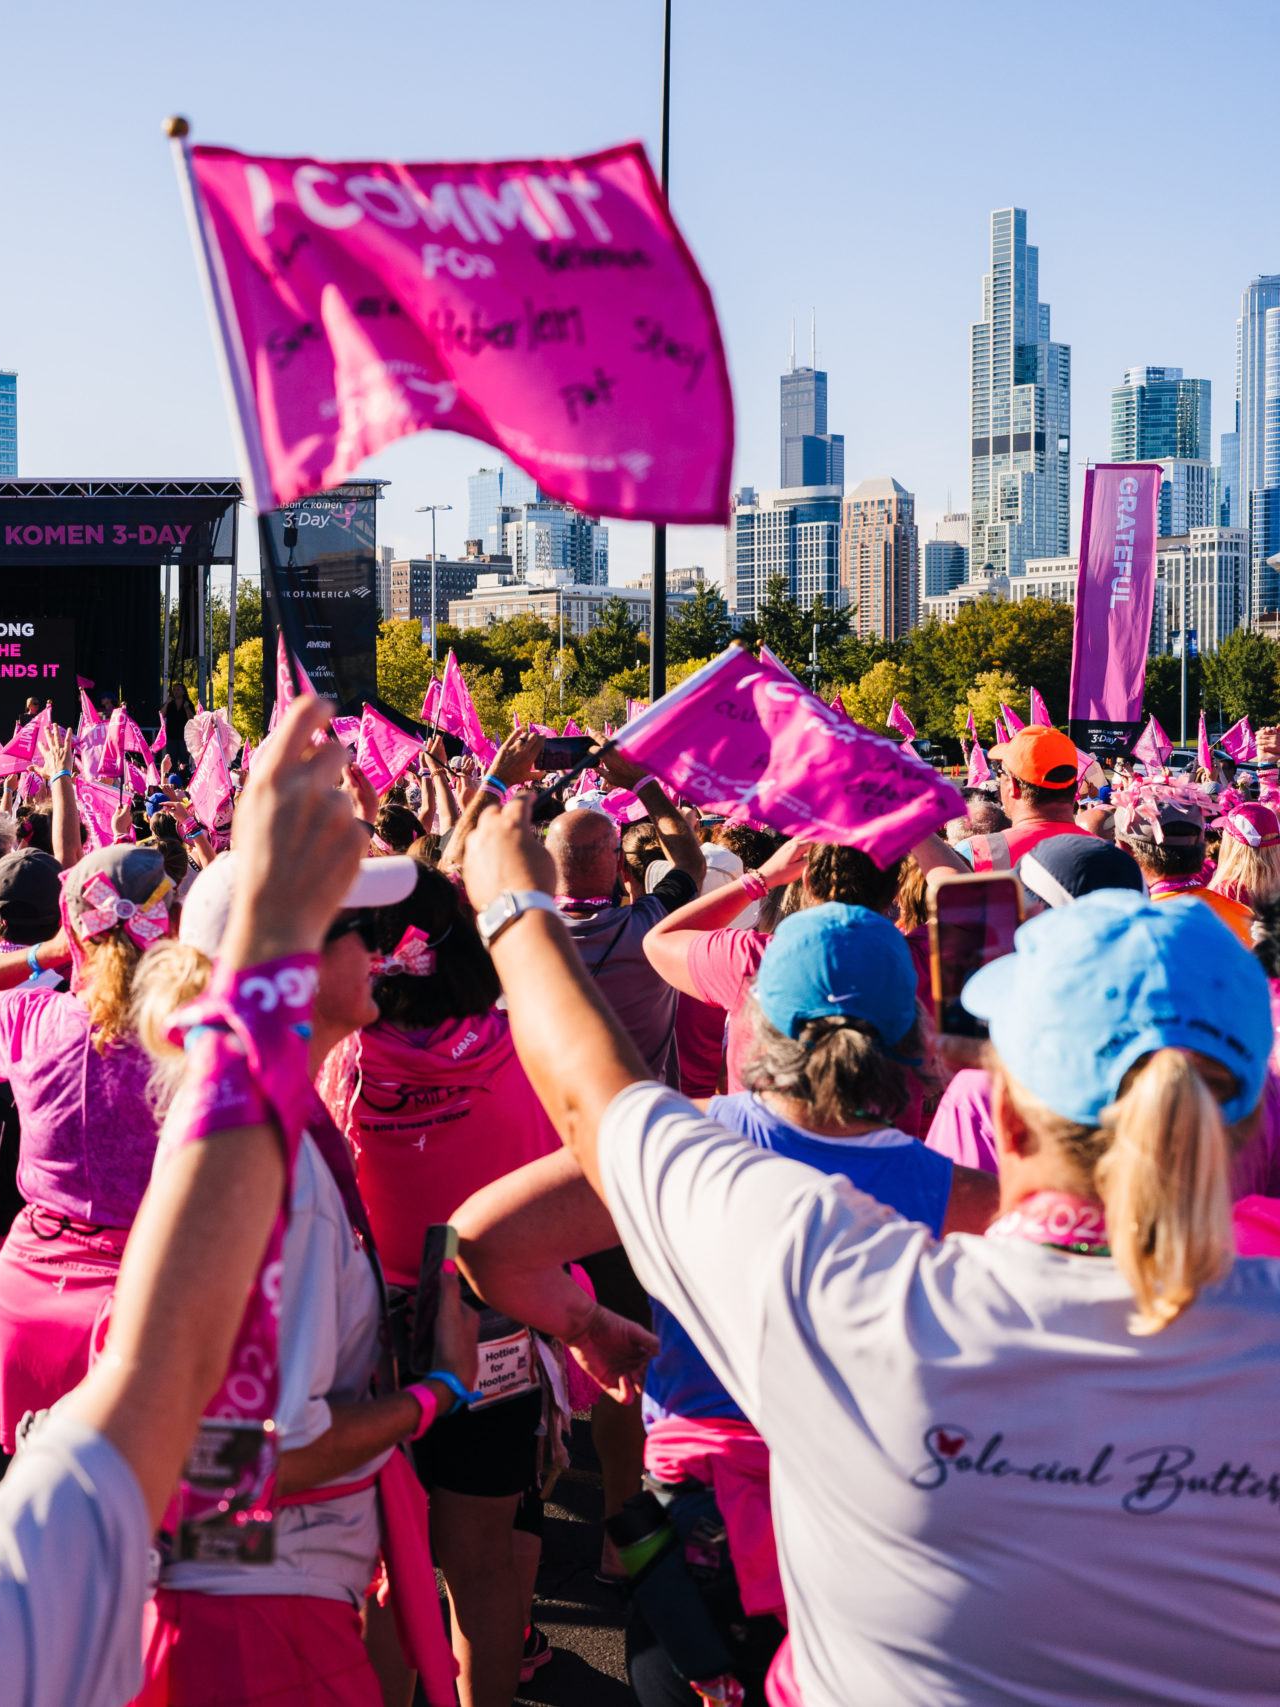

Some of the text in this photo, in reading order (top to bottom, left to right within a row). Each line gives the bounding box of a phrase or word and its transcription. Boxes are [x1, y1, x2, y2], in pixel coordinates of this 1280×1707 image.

[293, 163, 613, 243] COMMIT
[421, 243, 497, 281] FOR
[5, 525, 104, 545] KOMEN
[112, 525, 192, 545] 3-DAY
[1109, 476, 1138, 609] GRATEFUL
[266, 590, 351, 598] BNK OF AMERICA
[305, 640, 332, 649] AMGEN
[42, 664, 59, 678] IT
[451, 1031, 479, 1060] Every
[397, 1119, 433, 1131] breast
[435, 1108, 472, 1124] cancer
[485, 1346, 520, 1362] Hotties
[490, 1362, 505, 1373] for
[478, 1371, 516, 1390] Hooters
